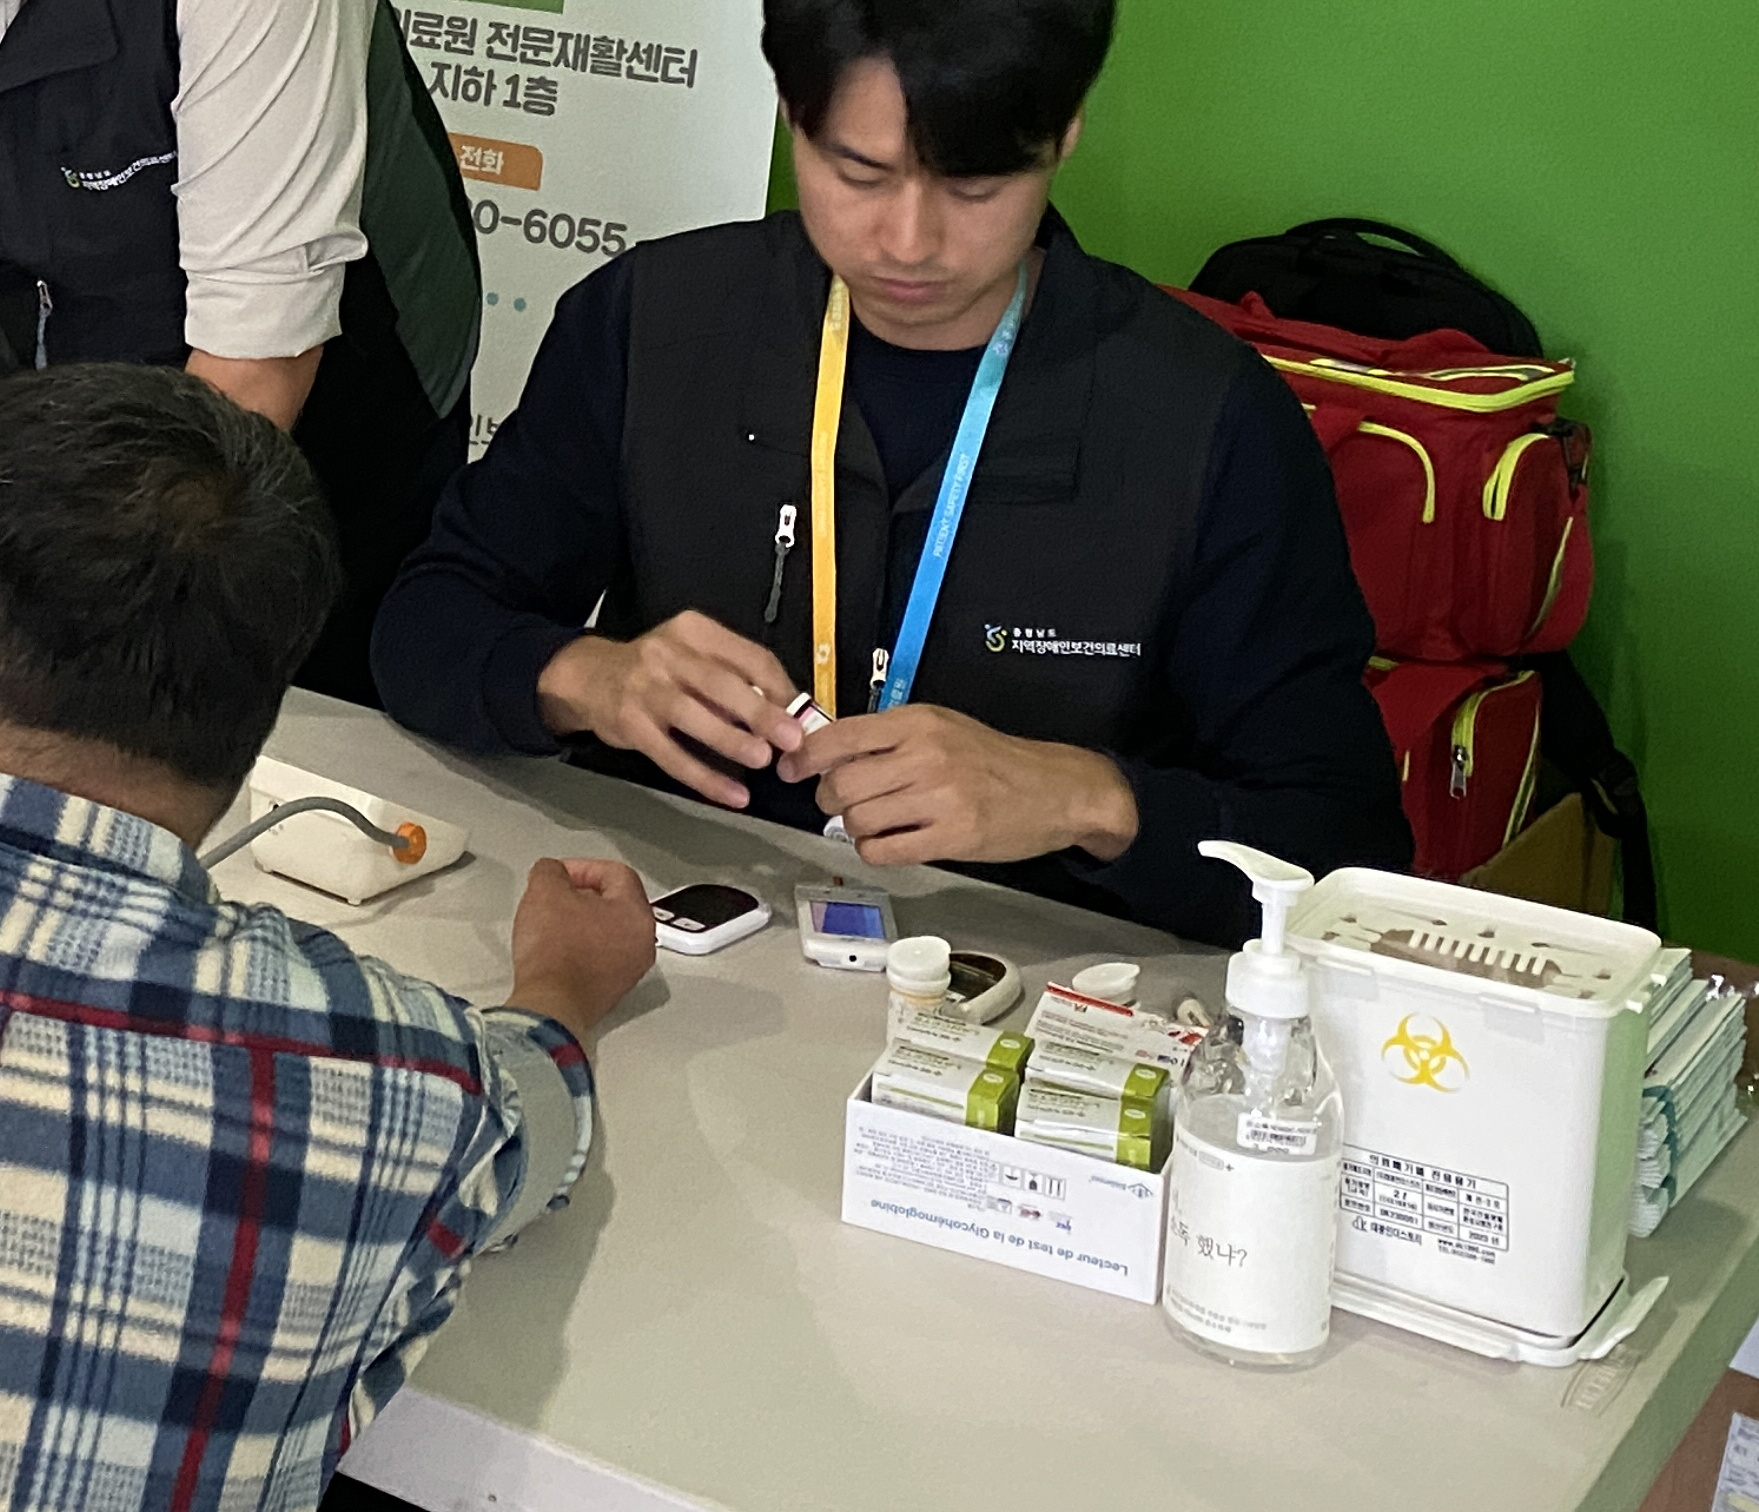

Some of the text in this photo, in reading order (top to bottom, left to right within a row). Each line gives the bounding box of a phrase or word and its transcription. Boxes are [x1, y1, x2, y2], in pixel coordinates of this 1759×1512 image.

[486, 21, 698, 89] 전문재활센터
[429, 61, 559, 117] 지하 1층
[459, 145, 505, 175] 전화
[467, 199, 628, 257] 0-6055
[1012, 640, 1141, 657] 지역장애인보건의료센터
[992, 1229, 1005, 1244] la
[1008, 1233, 1025, 1248] de
[1029, 1238, 1054, 1255] test
[1056, 1244, 1074, 1260] de
[1077, 1251, 1129, 1276] Lecteur
